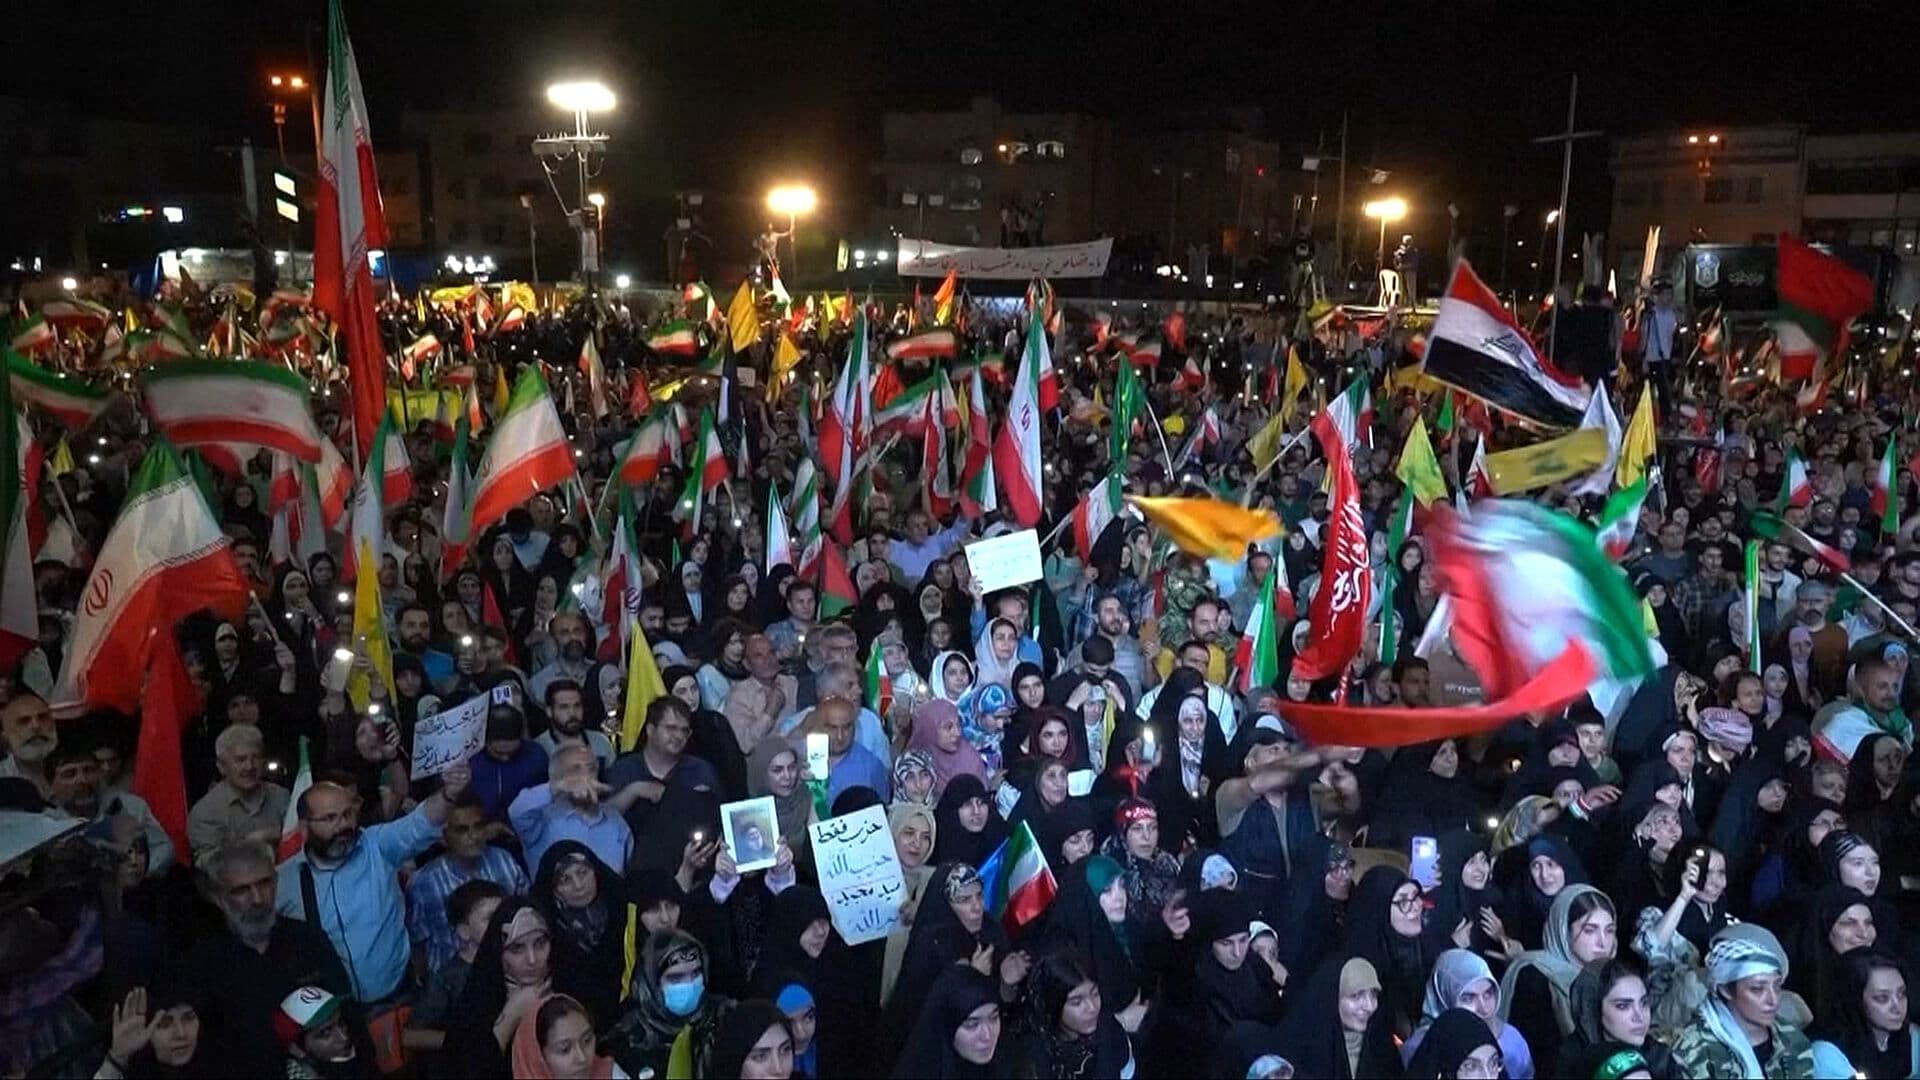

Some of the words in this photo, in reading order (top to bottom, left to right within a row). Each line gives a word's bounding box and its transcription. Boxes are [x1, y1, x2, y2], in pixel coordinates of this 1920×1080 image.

[817, 819, 848, 844] فقط
[838, 820, 883, 848] حزب
[827, 849, 850, 880] الله
[849, 854, 893, 879] حزب
